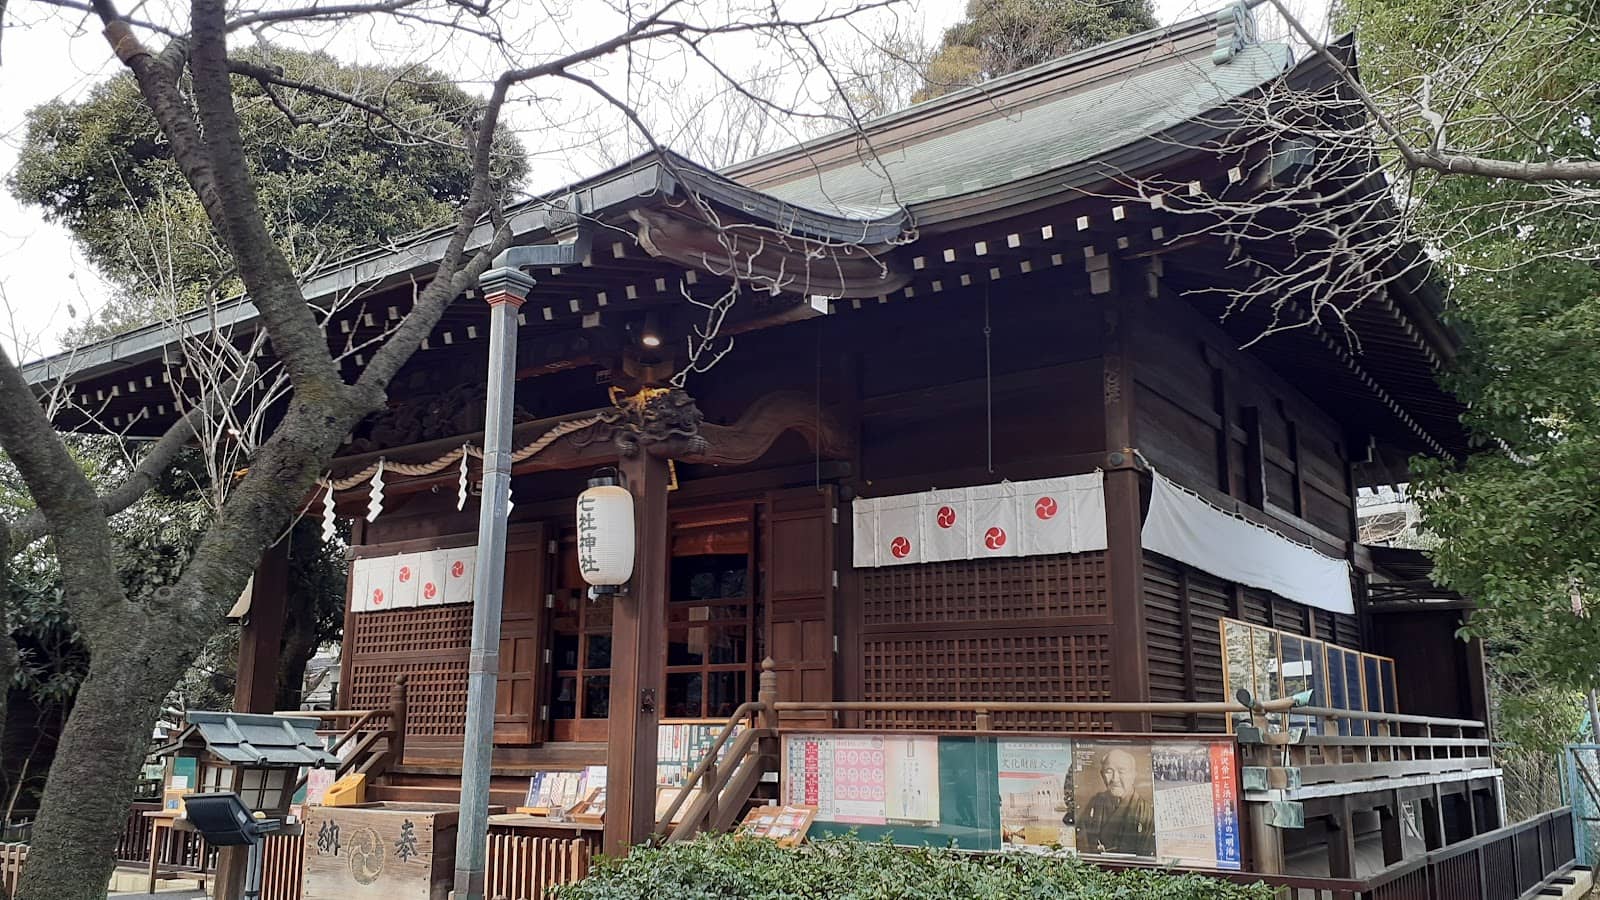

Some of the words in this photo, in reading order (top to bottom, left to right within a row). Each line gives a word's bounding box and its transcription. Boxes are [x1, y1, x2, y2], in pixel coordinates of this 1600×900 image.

[578, 495, 600, 574] 七社神社
[317, 819, 341, 856] 納
[394, 818, 419, 863] 奉
